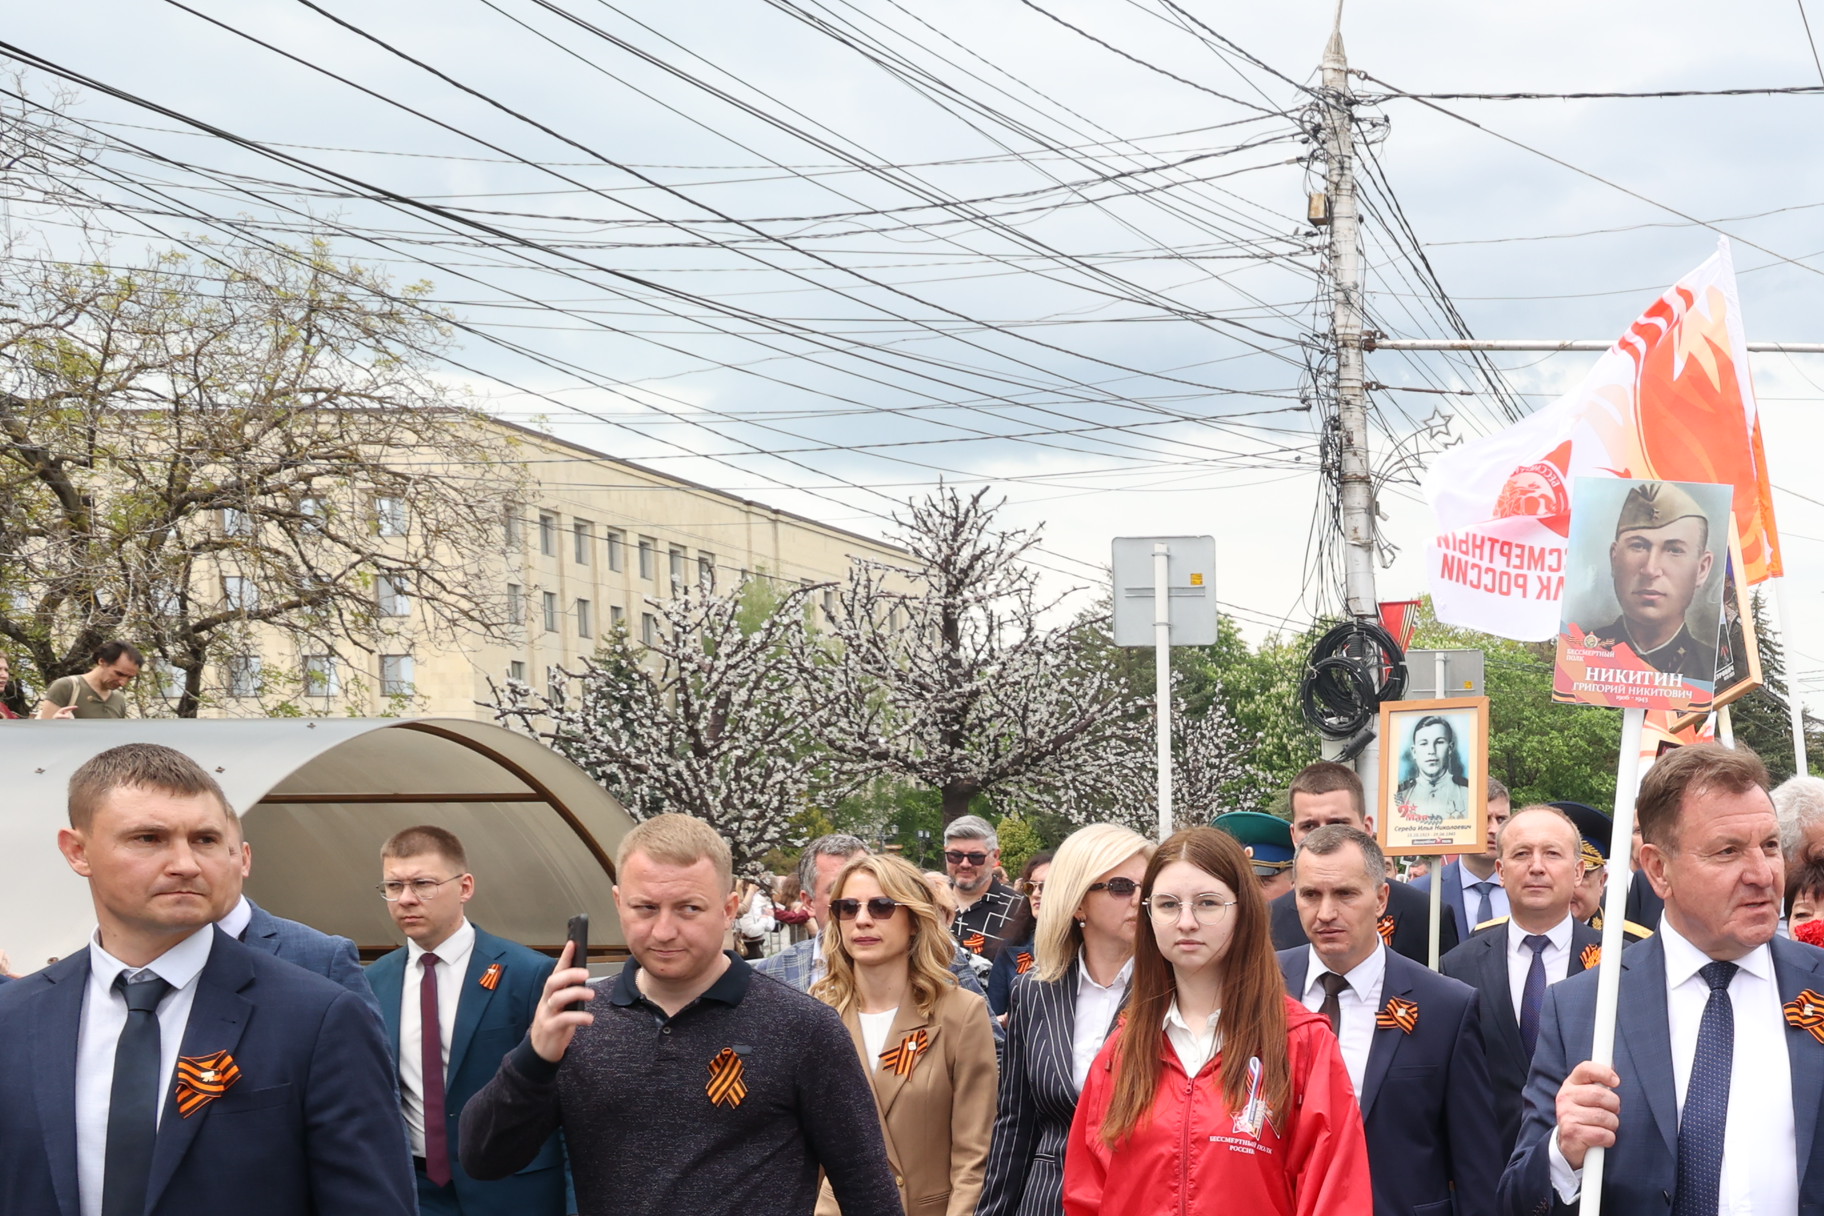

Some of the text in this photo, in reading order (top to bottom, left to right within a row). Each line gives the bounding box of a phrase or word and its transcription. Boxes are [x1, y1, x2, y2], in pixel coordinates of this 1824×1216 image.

[1566, 648, 1615, 658] БЕССМЕРТНЫЙ
[1585, 667, 1683, 687] НИКИТИН
[1573, 682, 1692, 699] ГРИГОРИЙ НИКИТОВИЧ
[1209, 1136, 1256, 1148] БЕССМЕРТНЫЙ
